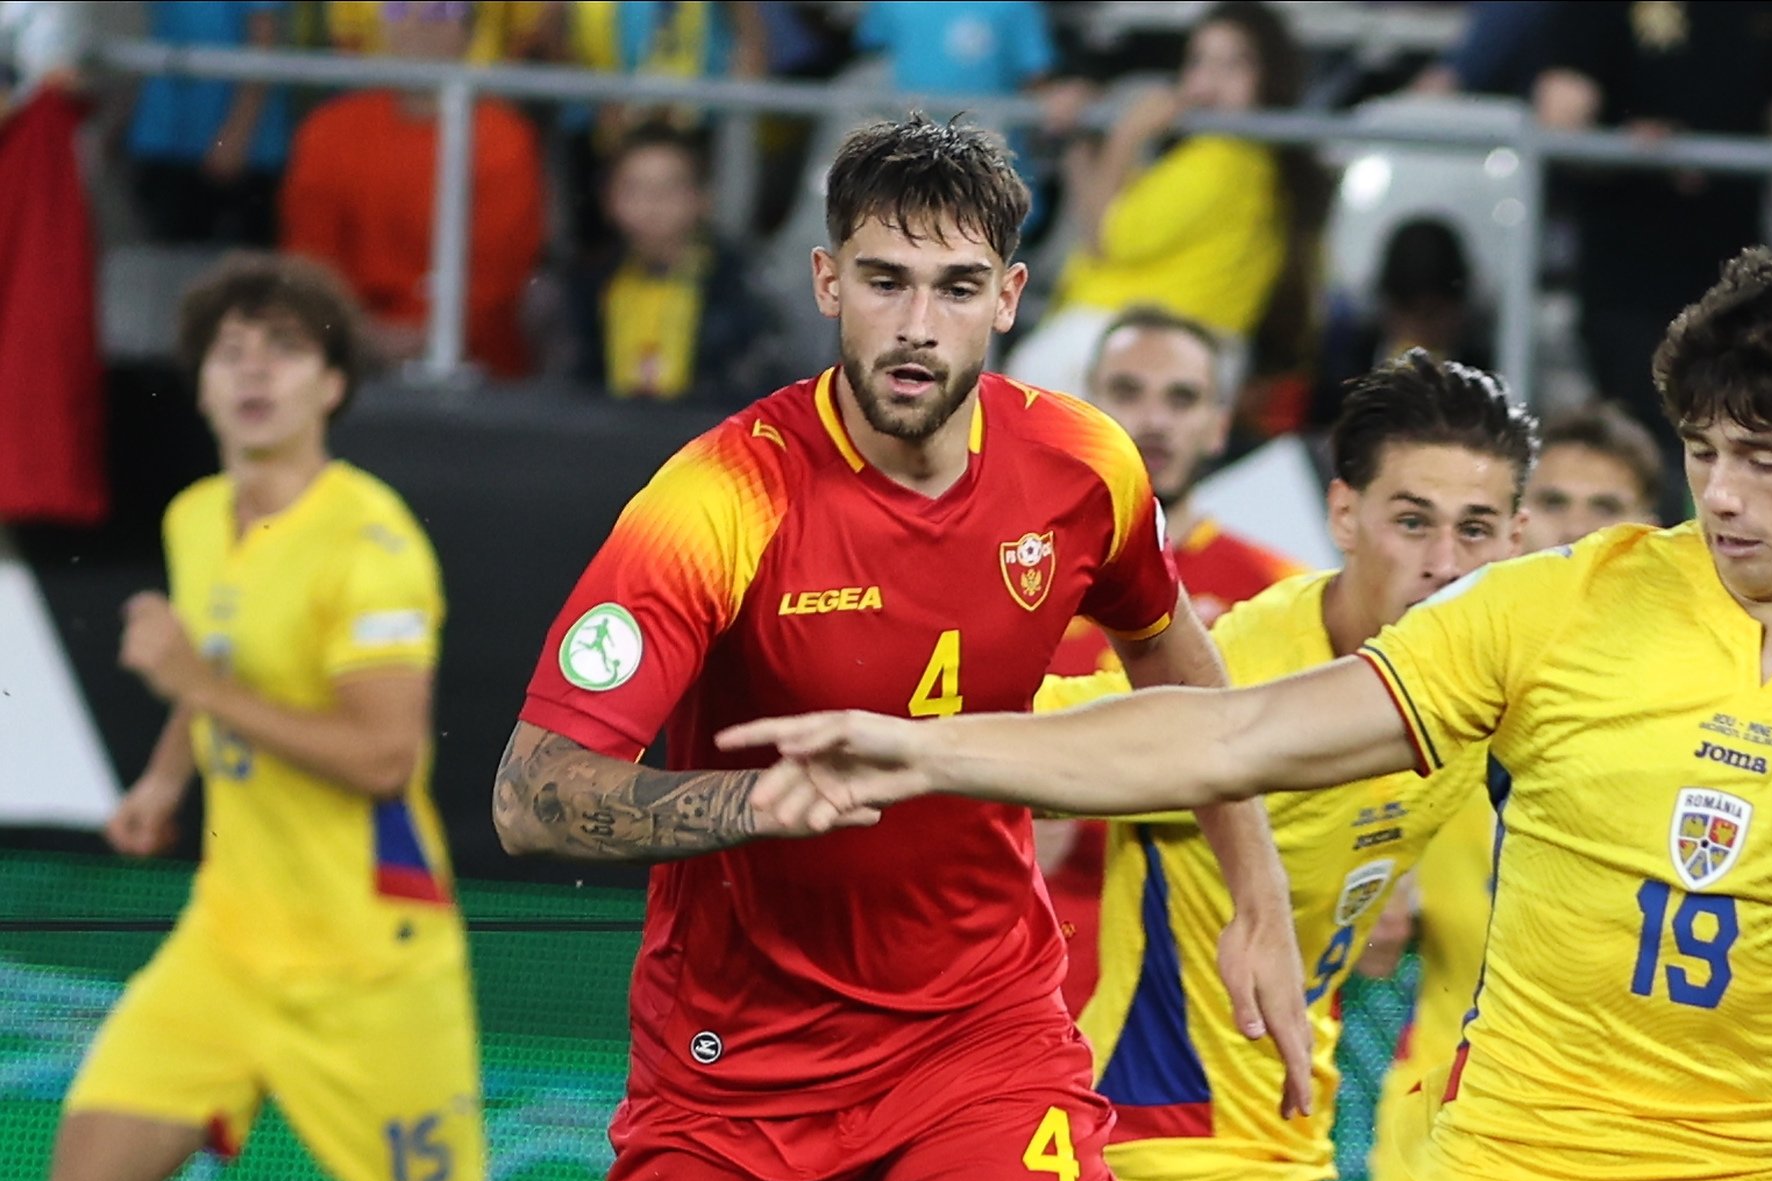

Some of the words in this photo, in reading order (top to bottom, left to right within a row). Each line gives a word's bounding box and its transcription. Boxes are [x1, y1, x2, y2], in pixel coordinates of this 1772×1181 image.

[778, 586, 883, 616] LEGEA
[907, 629, 963, 719] 4
[1684, 793, 1744, 820] ROMÂNIA
[1630, 878, 1739, 1010] 19
